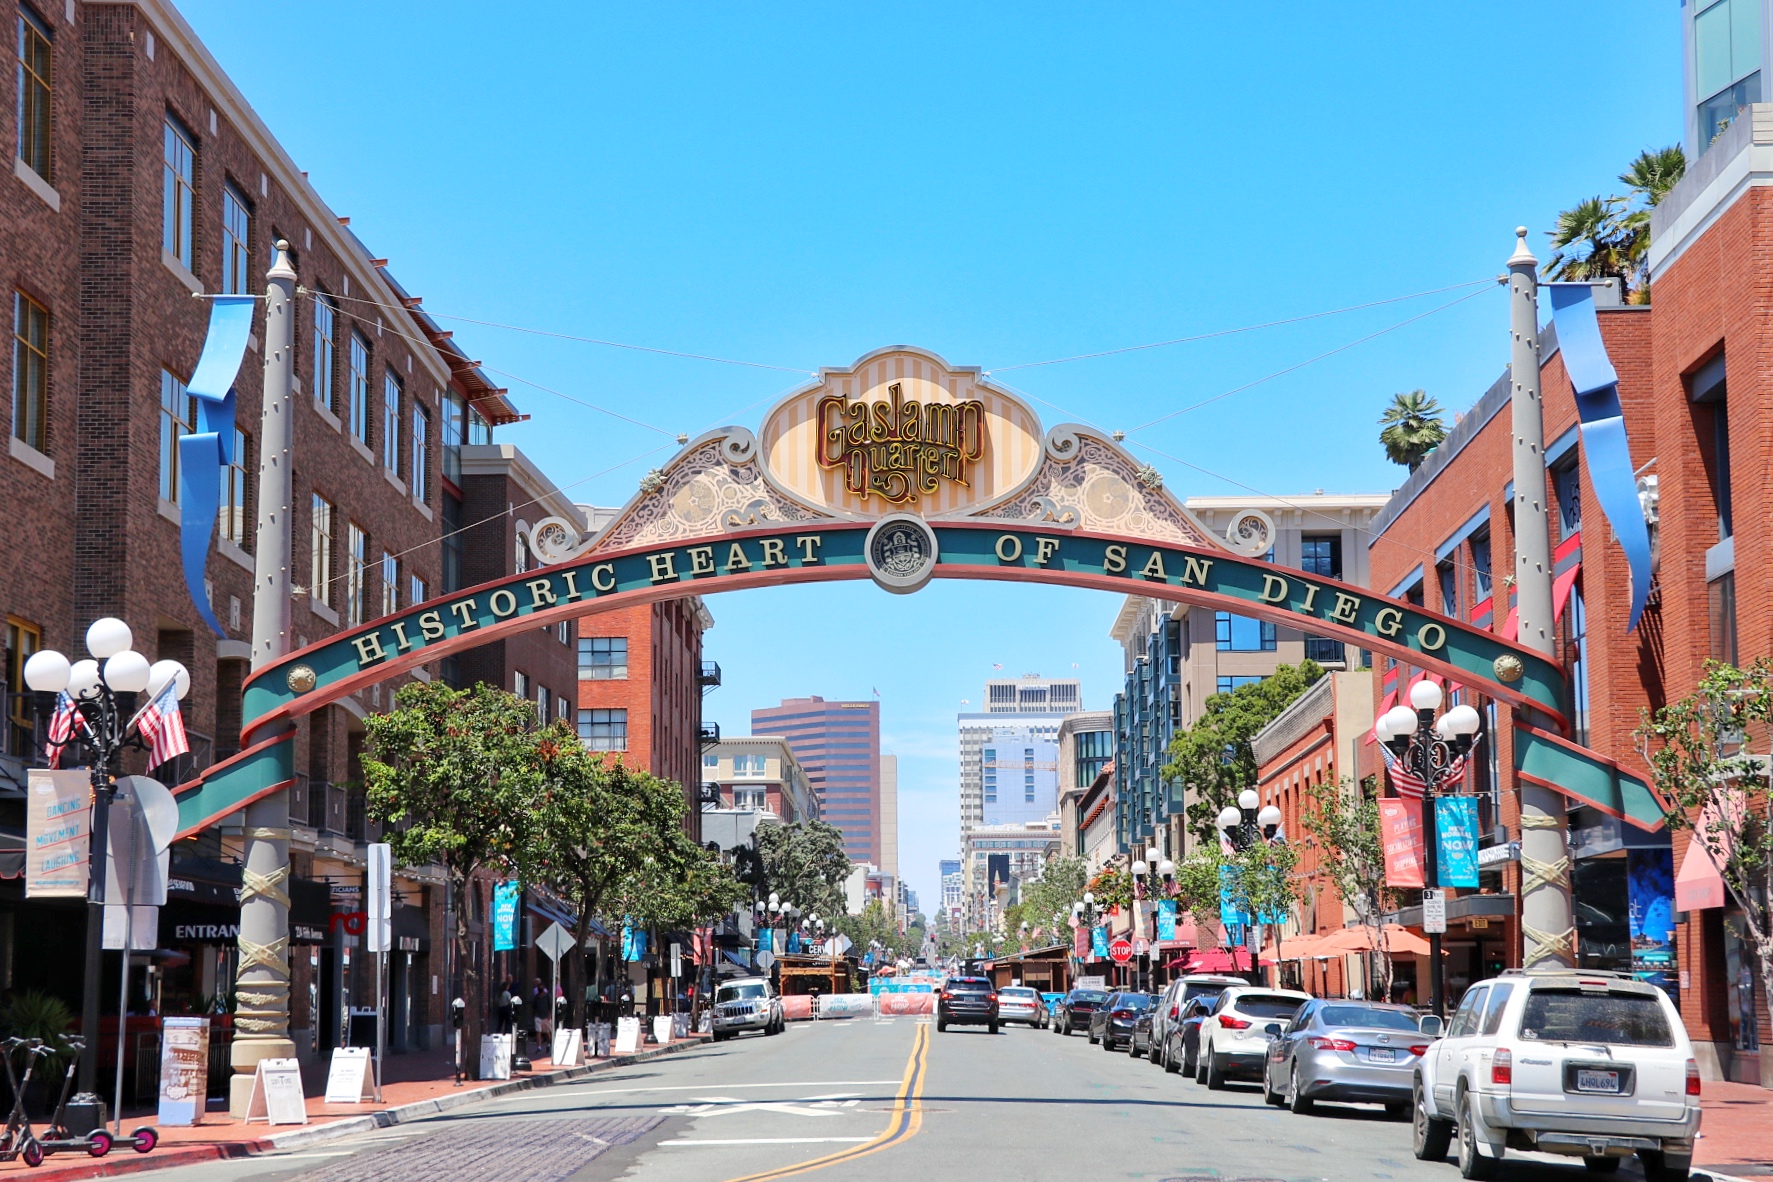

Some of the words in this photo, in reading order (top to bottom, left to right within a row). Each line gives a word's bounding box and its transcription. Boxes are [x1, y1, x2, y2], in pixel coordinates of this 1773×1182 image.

[815, 382, 985, 489] Gaslamp
[844, 442, 959, 504] Quarter
[351, 563, 616, 665] HISTORIC
[646, 535, 821, 582] HEART
[995, 534, 1060, 564] OF
[1103, 545, 1214, 586] SAN
[1258, 573, 1446, 650] DIEGO
[46, 798, 81, 818] DANCING
[35, 824, 80, 847] MOVEMENT
[1393, 818, 1417, 833] PLAYING
[1441, 840, 1475, 851] NOW
[40, 850, 80, 873] LAUGHING
[1393, 856, 1417, 869] SHOPPIN
[1112, 946, 1131, 956] STOP
